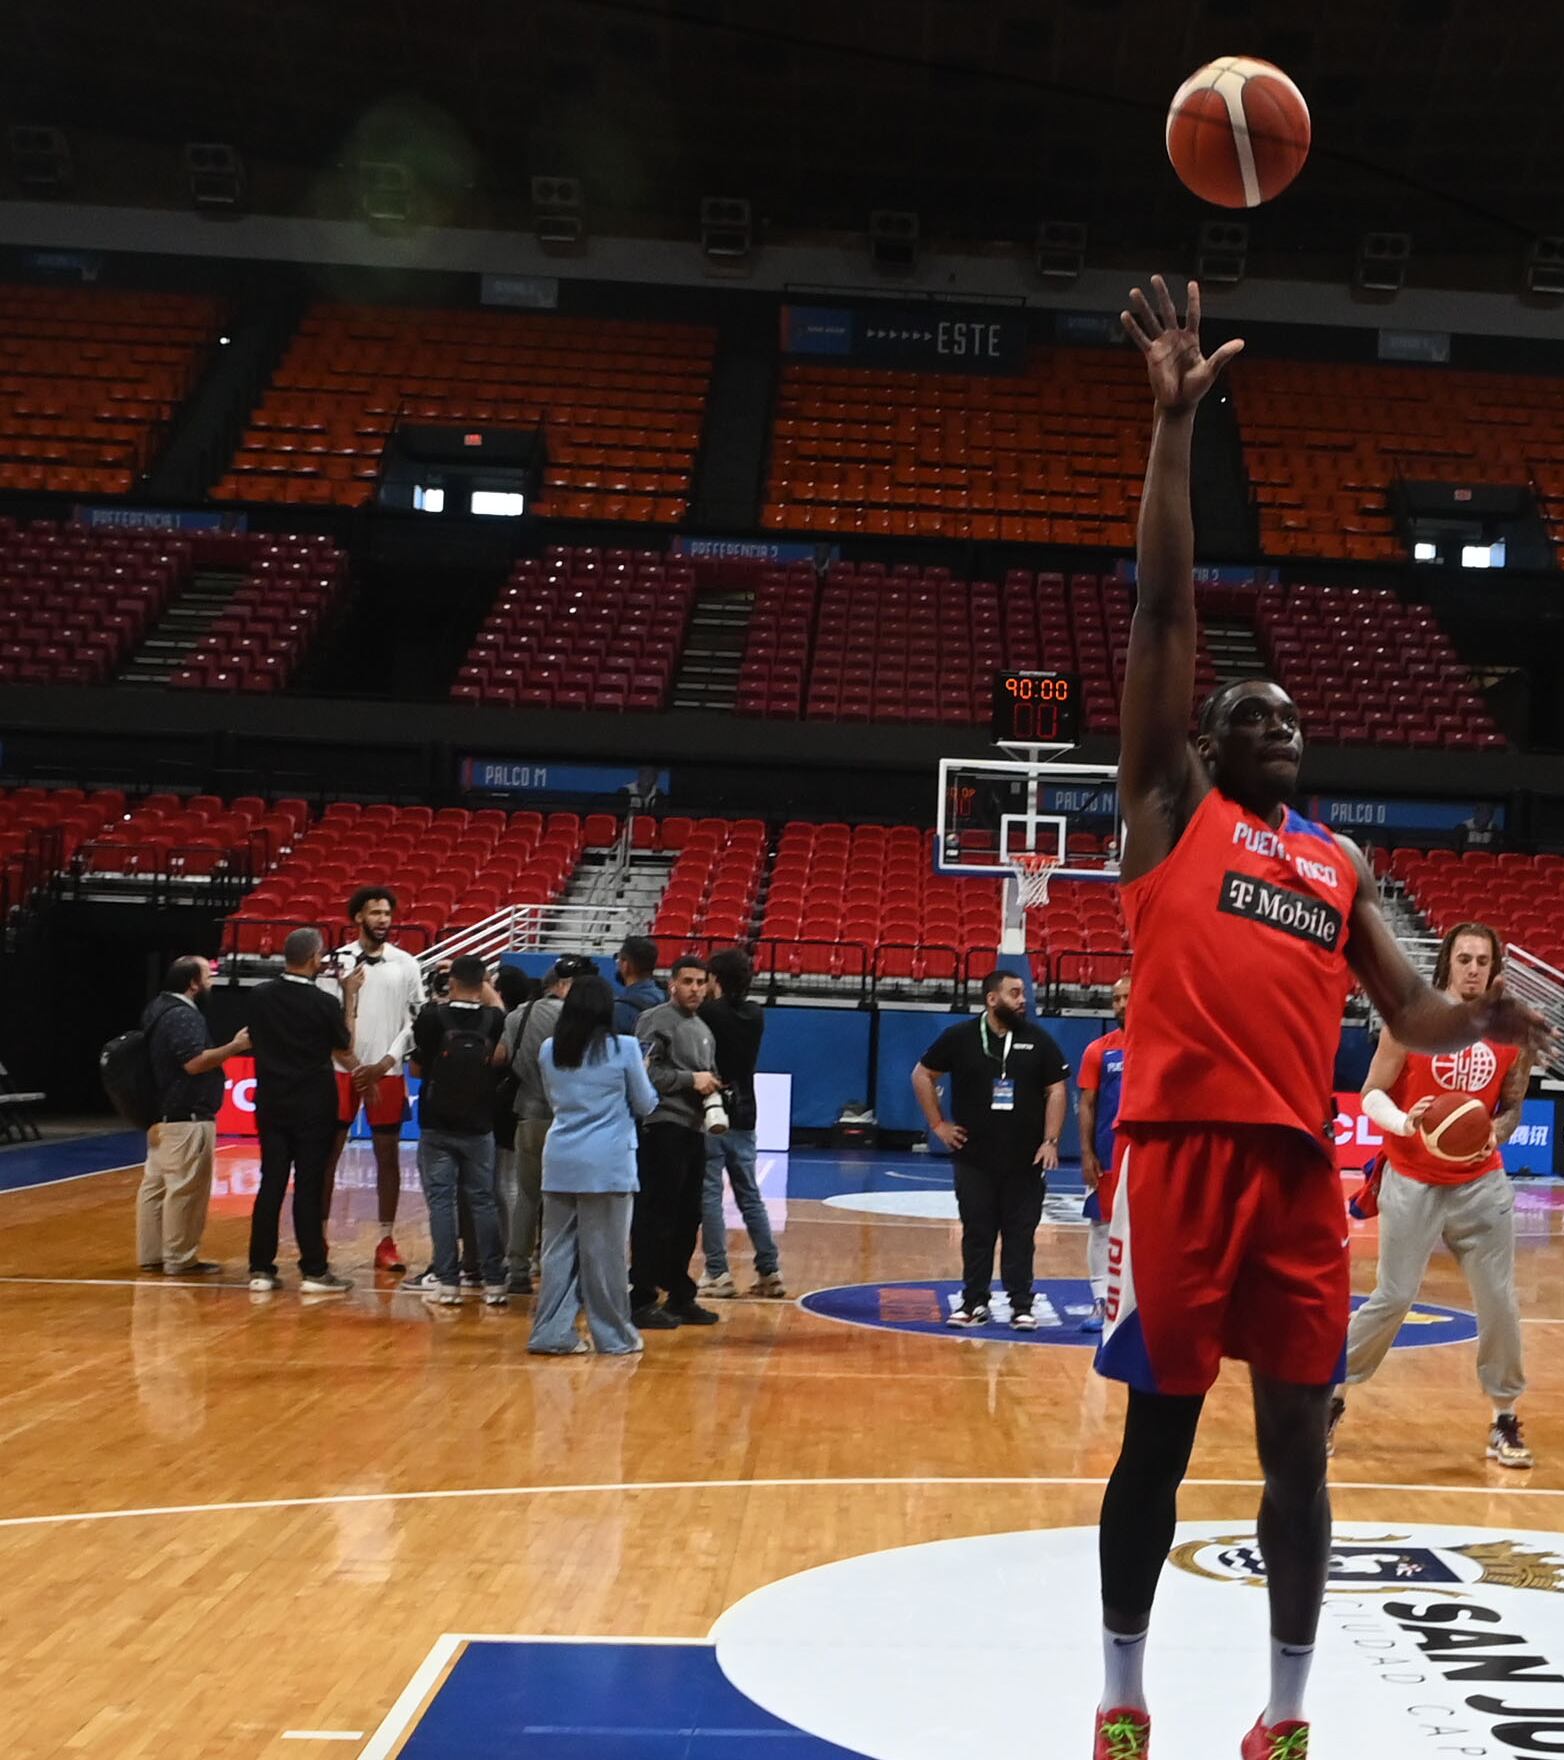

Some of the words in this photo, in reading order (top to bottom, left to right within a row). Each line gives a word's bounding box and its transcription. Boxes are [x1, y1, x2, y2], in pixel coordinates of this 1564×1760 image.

[937, 321, 1000, 357] ESTE
[1004, 677, 1069, 700] 90:00
[485, 765, 529, 786] PALCO
[534, 768, 546, 787] M
[1055, 791, 1098, 811] PALCO
[1331, 802, 1373, 822] PALCO
[1229, 879, 1255, 910] T
[1255, 887, 1336, 943] Mobile
[1334, 1113, 1384, 1146] CL
[1322, 1600, 1426, 1683] CIUDAD
[1406, 1704, 1487, 1756] CAP
